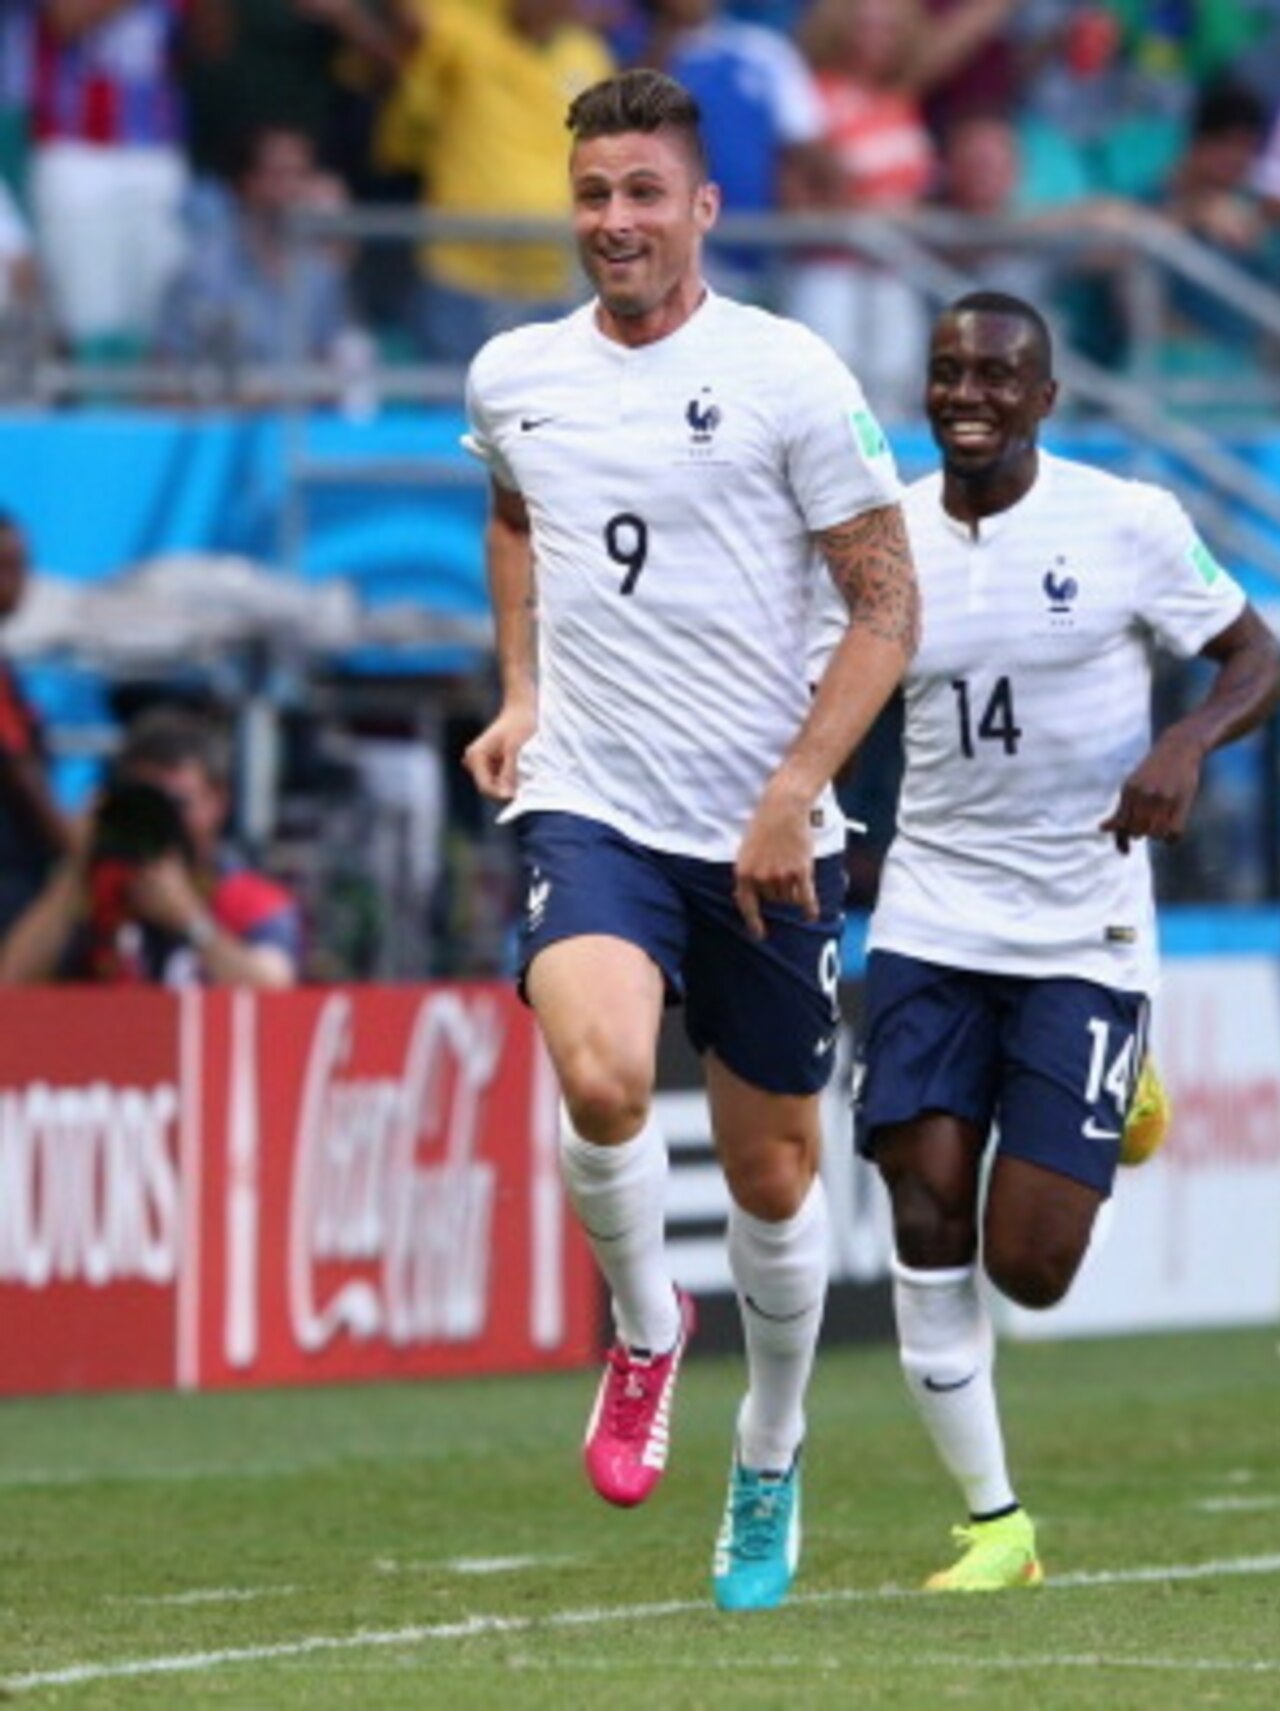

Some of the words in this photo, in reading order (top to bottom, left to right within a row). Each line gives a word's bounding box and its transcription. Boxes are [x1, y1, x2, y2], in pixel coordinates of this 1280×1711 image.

[604, 512, 648, 595] 9
[952, 675, 1022, 759] 14
[818, 938, 842, 1023] 9
[1085, 1017, 1136, 1116] 14
